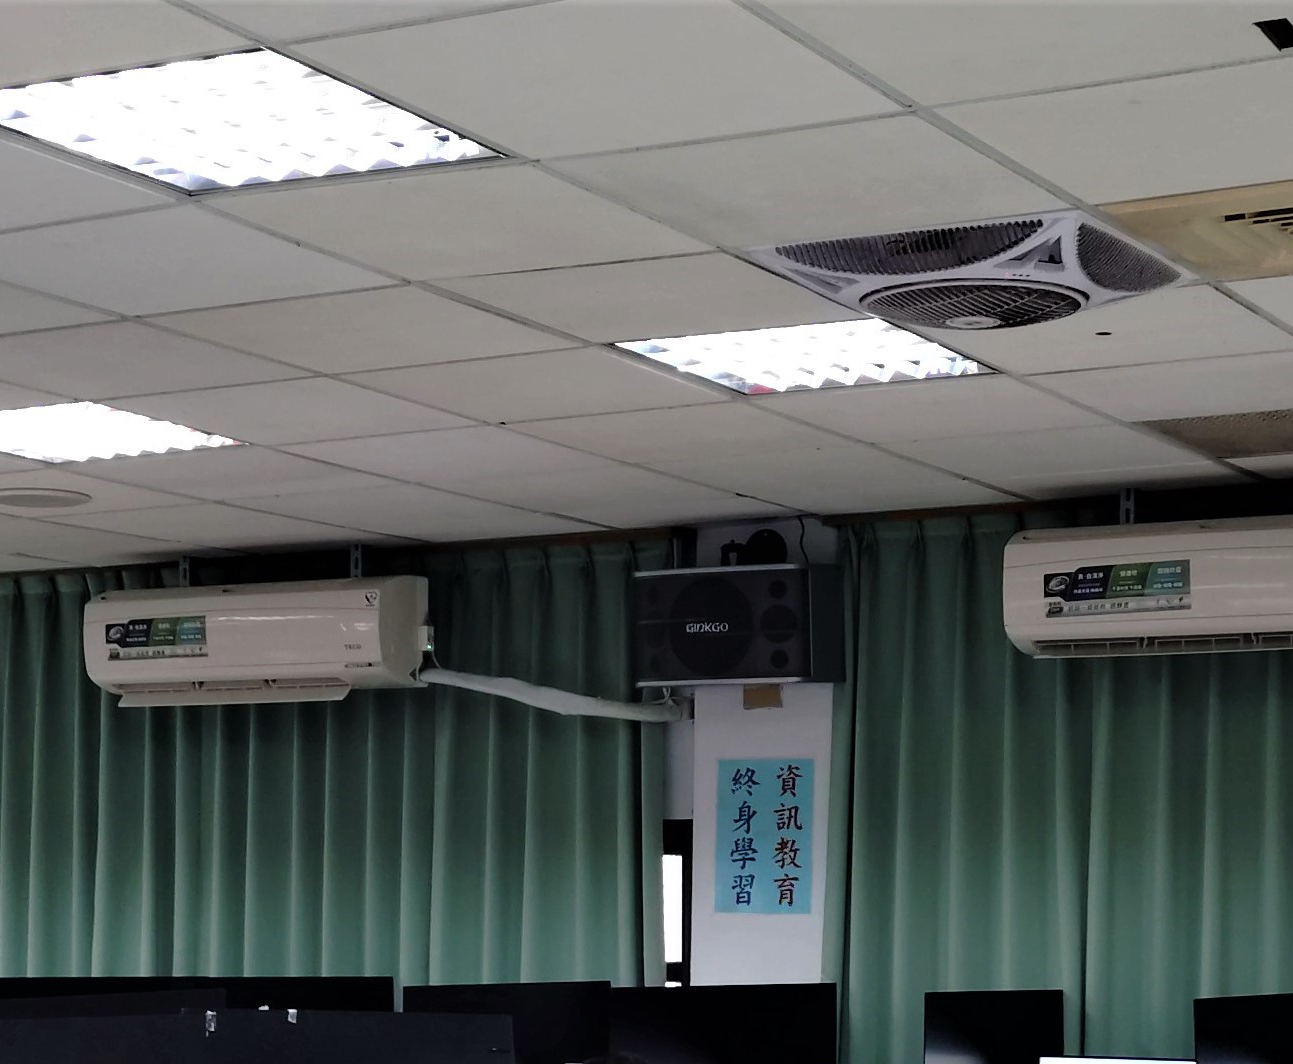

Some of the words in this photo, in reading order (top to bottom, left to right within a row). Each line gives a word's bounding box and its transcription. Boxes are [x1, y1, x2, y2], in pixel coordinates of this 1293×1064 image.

[686, 622, 729, 633] GINKGO
[730, 767, 761, 906] 終身學習
[772, 764, 804, 907] 資訊教育
